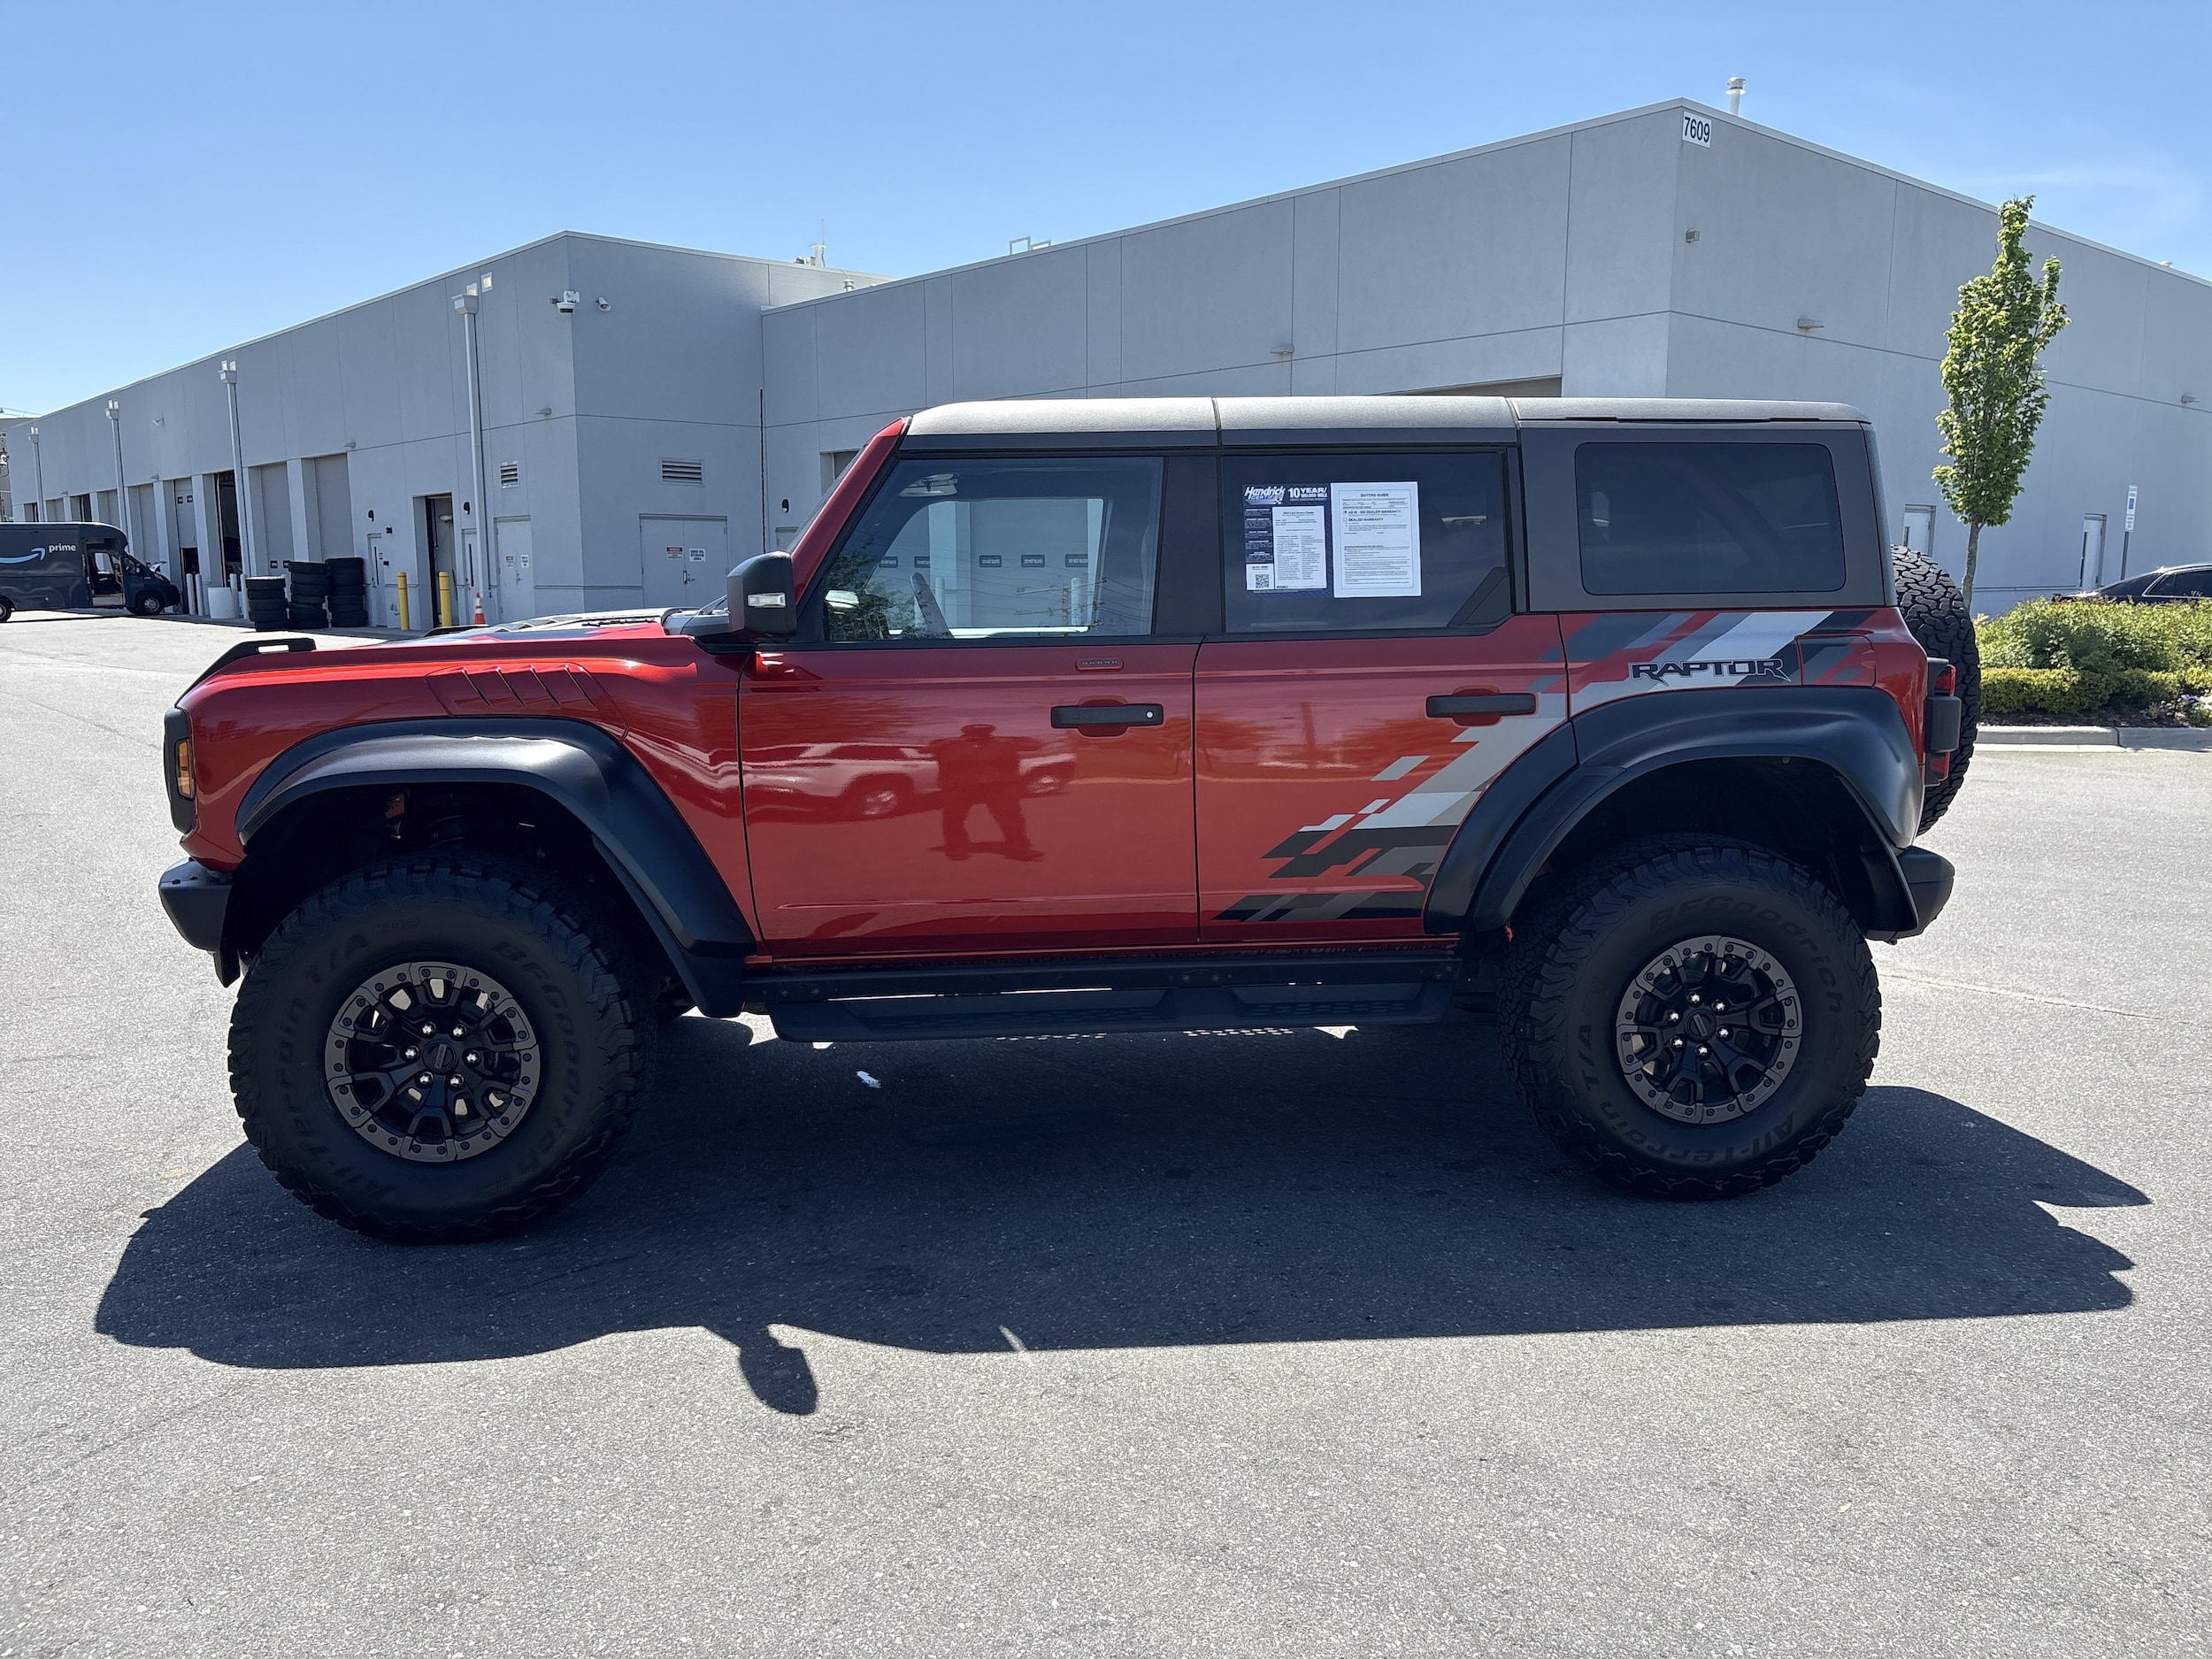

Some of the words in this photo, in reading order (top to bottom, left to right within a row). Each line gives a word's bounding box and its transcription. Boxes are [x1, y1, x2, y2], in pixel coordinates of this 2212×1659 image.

[1685, 116, 1710, 142] 7609
[1244, 486, 1286, 499] Hendrick
[1288, 487, 1301, 498] 10
[49, 543, 76, 553] prime
[1629, 658, 1791, 687] RAPTOR
[1650, 895, 1844, 1014] BFGoodrich
[491, 941, 581, 1175] BFGoodrich
[1578, 1024, 1601, 1092] T/A
